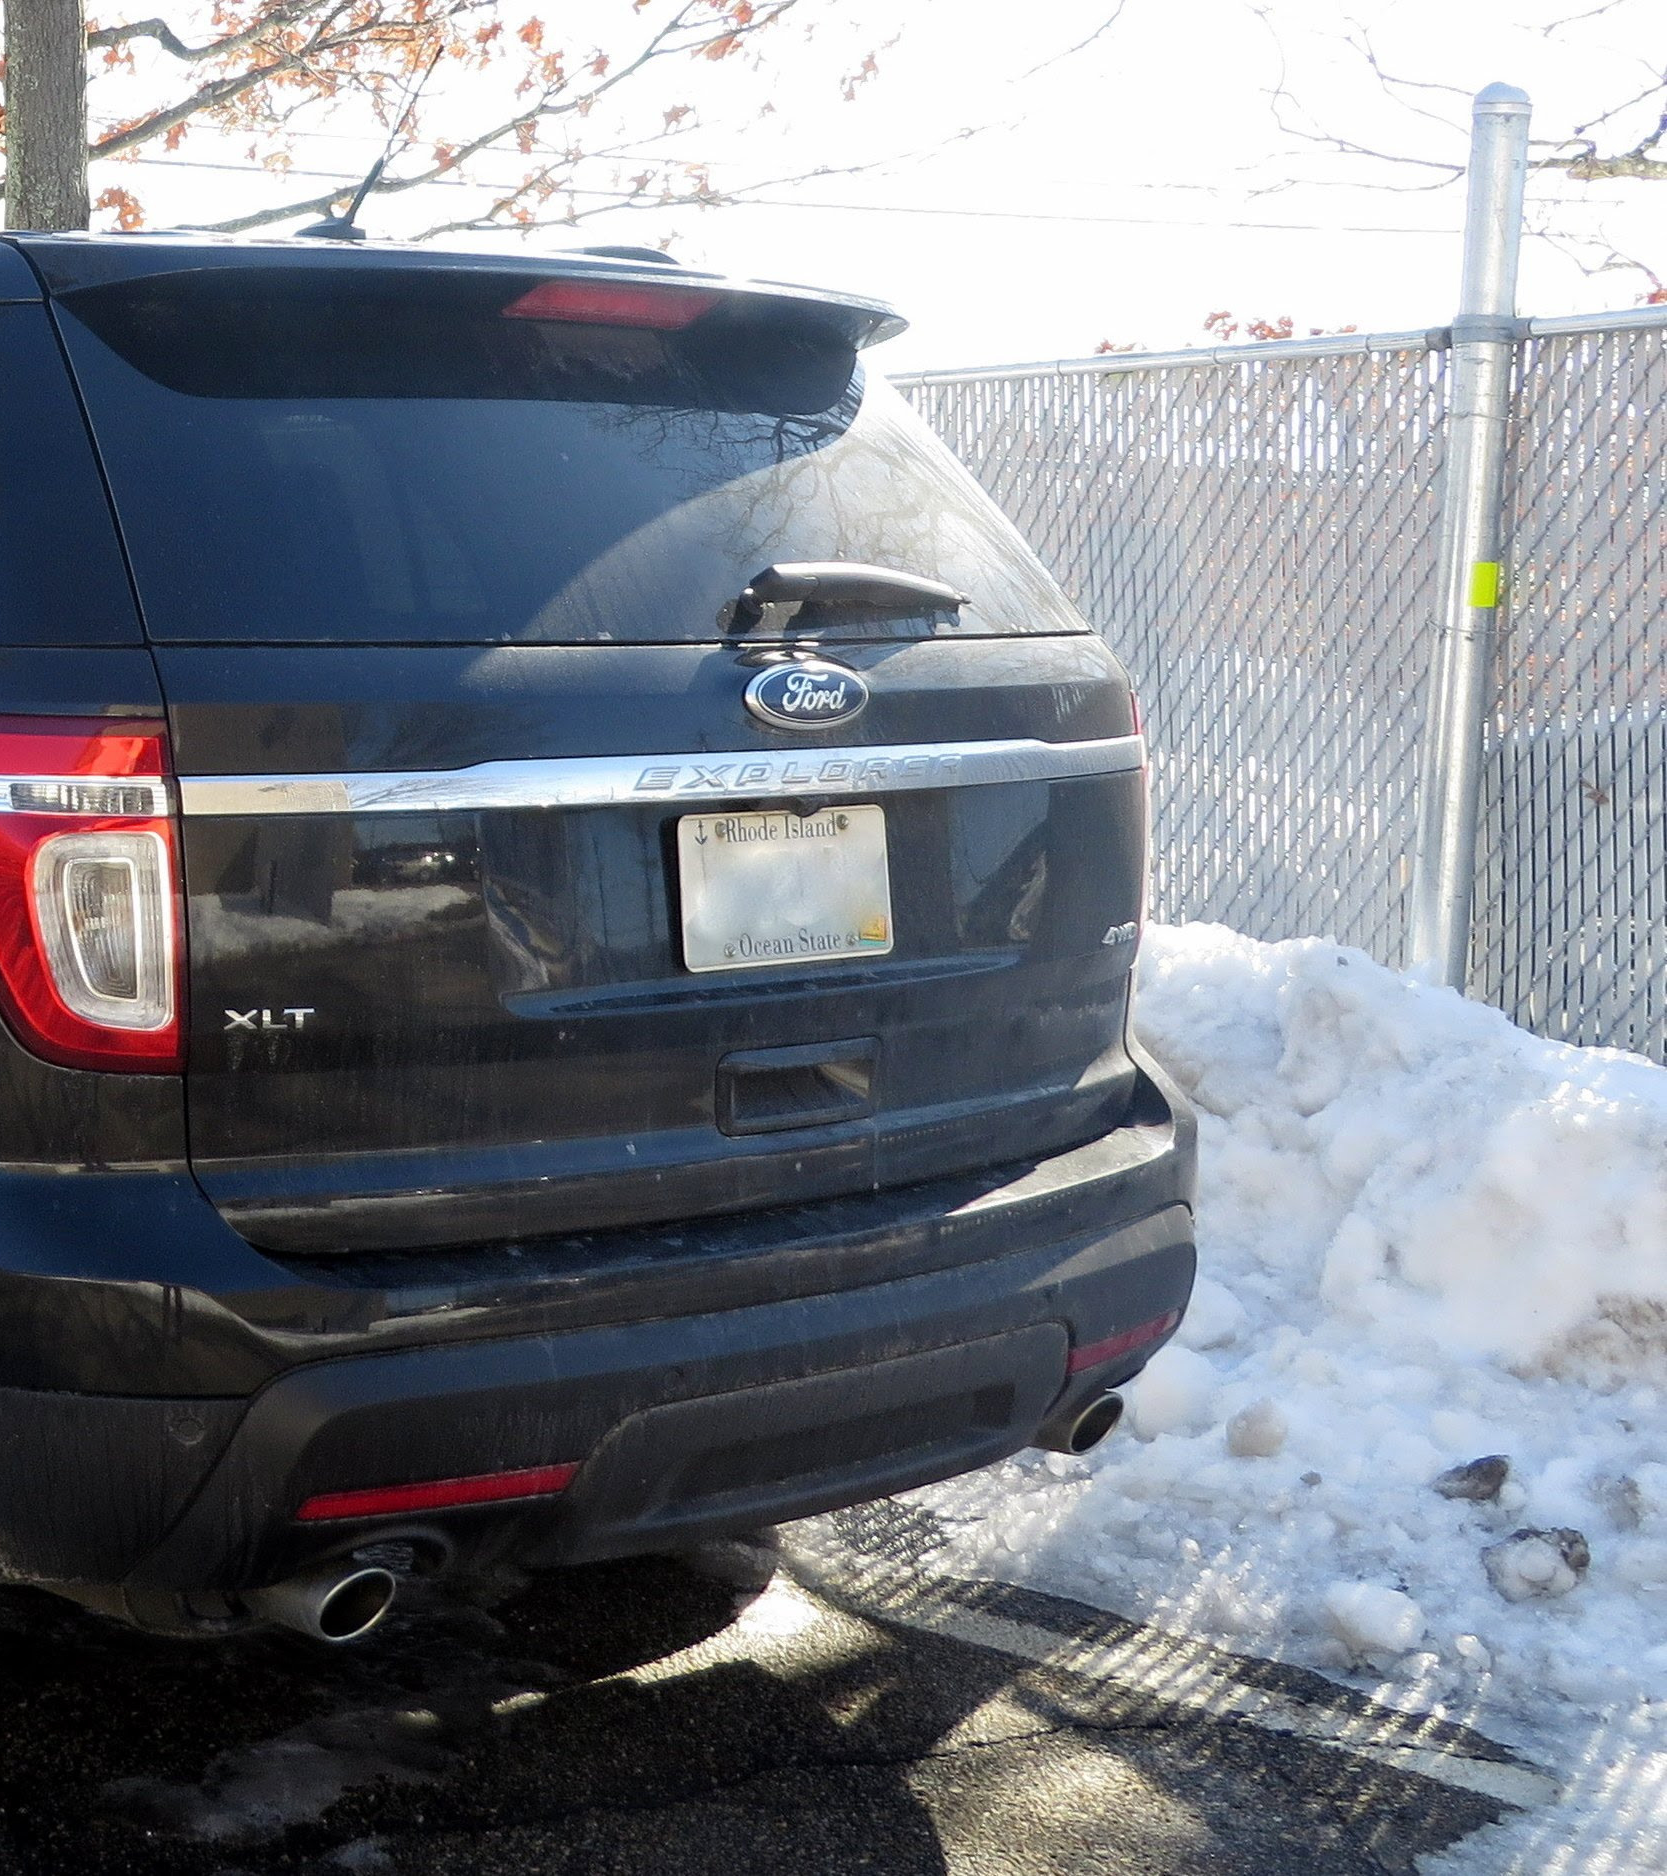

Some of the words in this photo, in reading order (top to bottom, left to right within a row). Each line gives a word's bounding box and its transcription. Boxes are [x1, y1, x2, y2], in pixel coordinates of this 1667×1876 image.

[782, 672, 846, 711] Ford
[635, 754, 963, 791] EXPLORER
[725, 816, 778, 843] Rhode
[783, 813, 838, 840] Island
[738, 932, 794, 958] Ocean
[798, 928, 841, 953] State
[1101, 921, 1138, 946] 4WD
[223, 1007, 315, 1030] XLT
